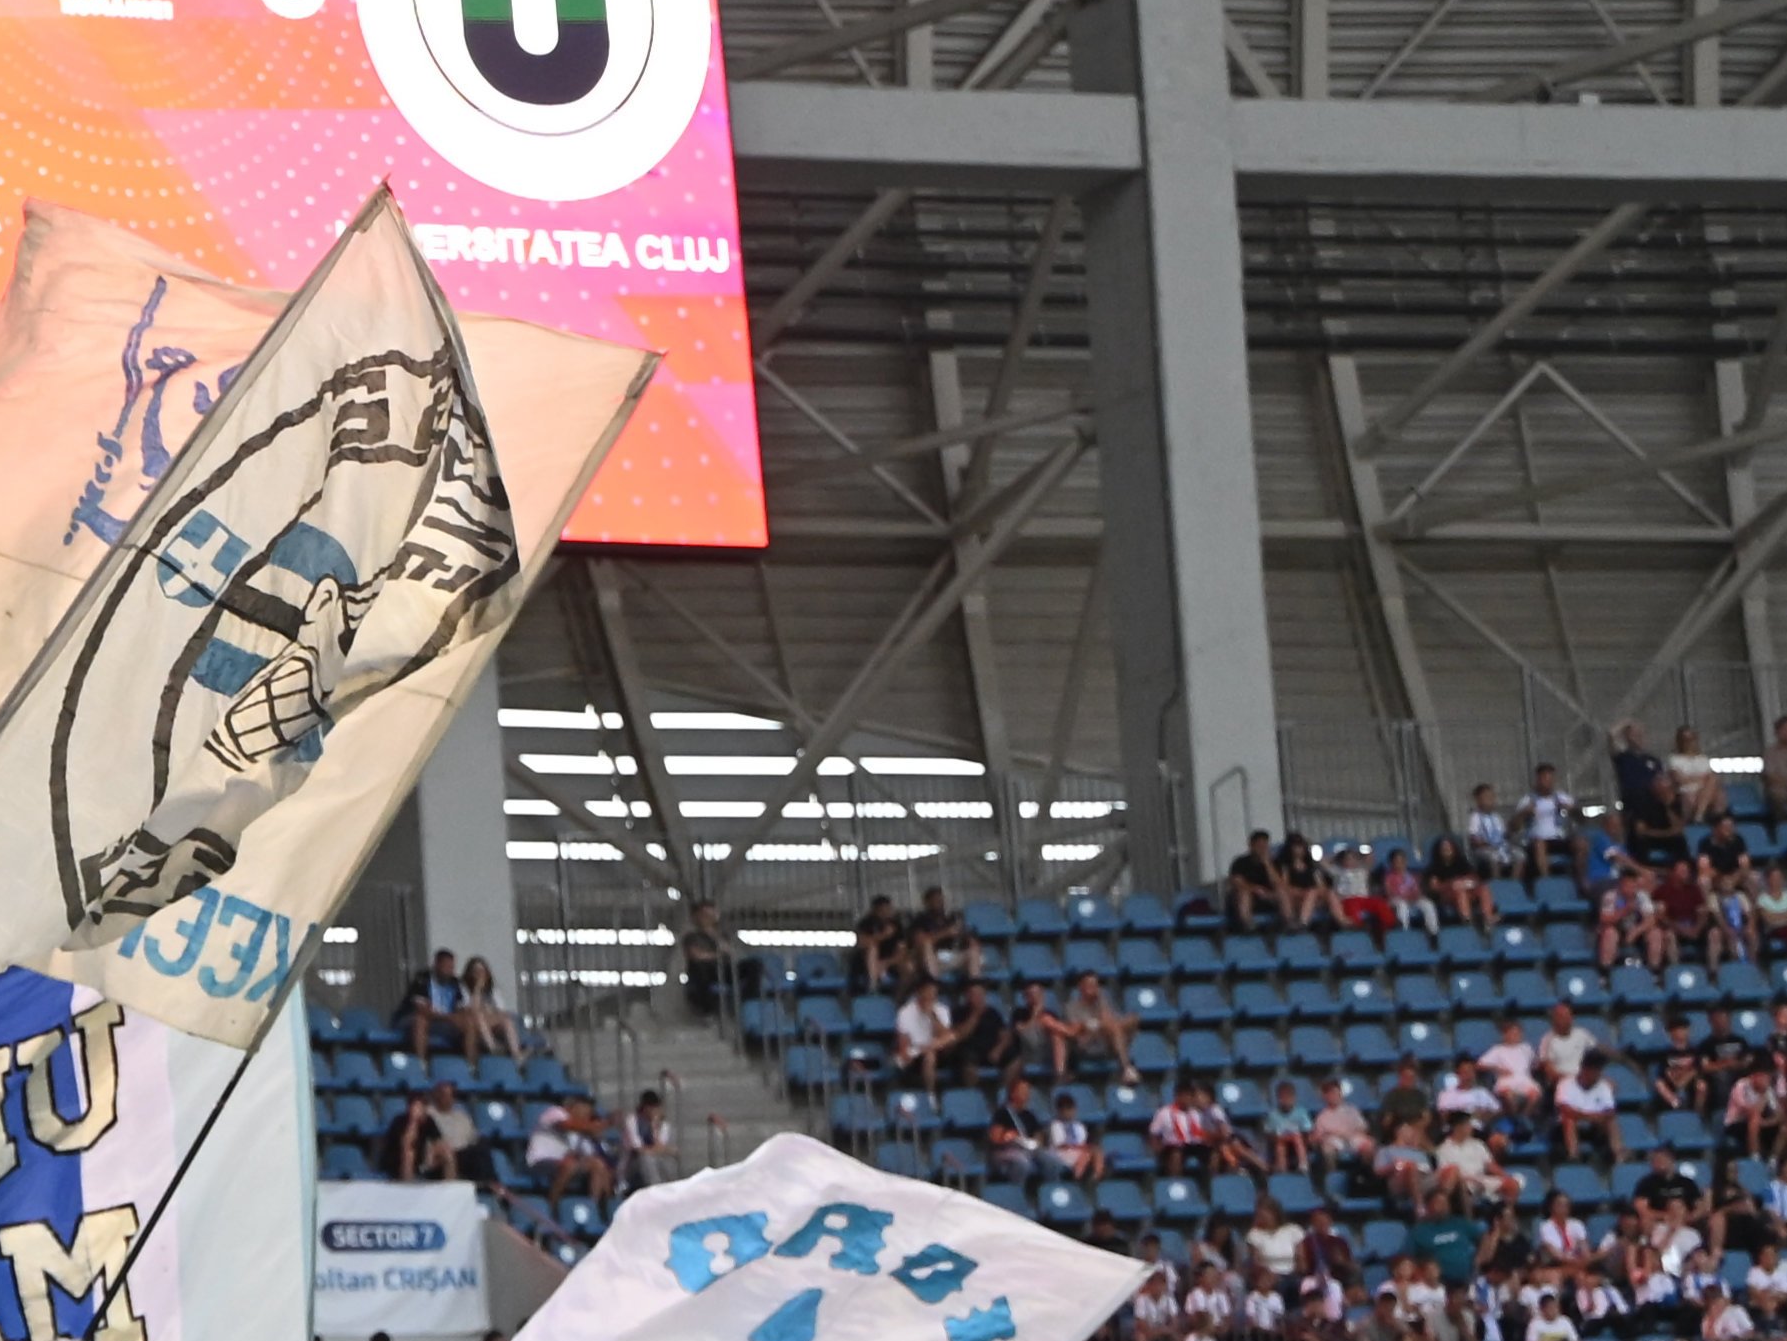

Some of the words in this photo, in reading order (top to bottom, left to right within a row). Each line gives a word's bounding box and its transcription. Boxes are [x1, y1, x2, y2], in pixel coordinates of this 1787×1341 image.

[634, 234, 730, 273] CLUJ
[331, 1223, 419, 1248] SECTOR
[420, 1226, 436, 1248] 7
[315, 1268, 377, 1291] oltan
